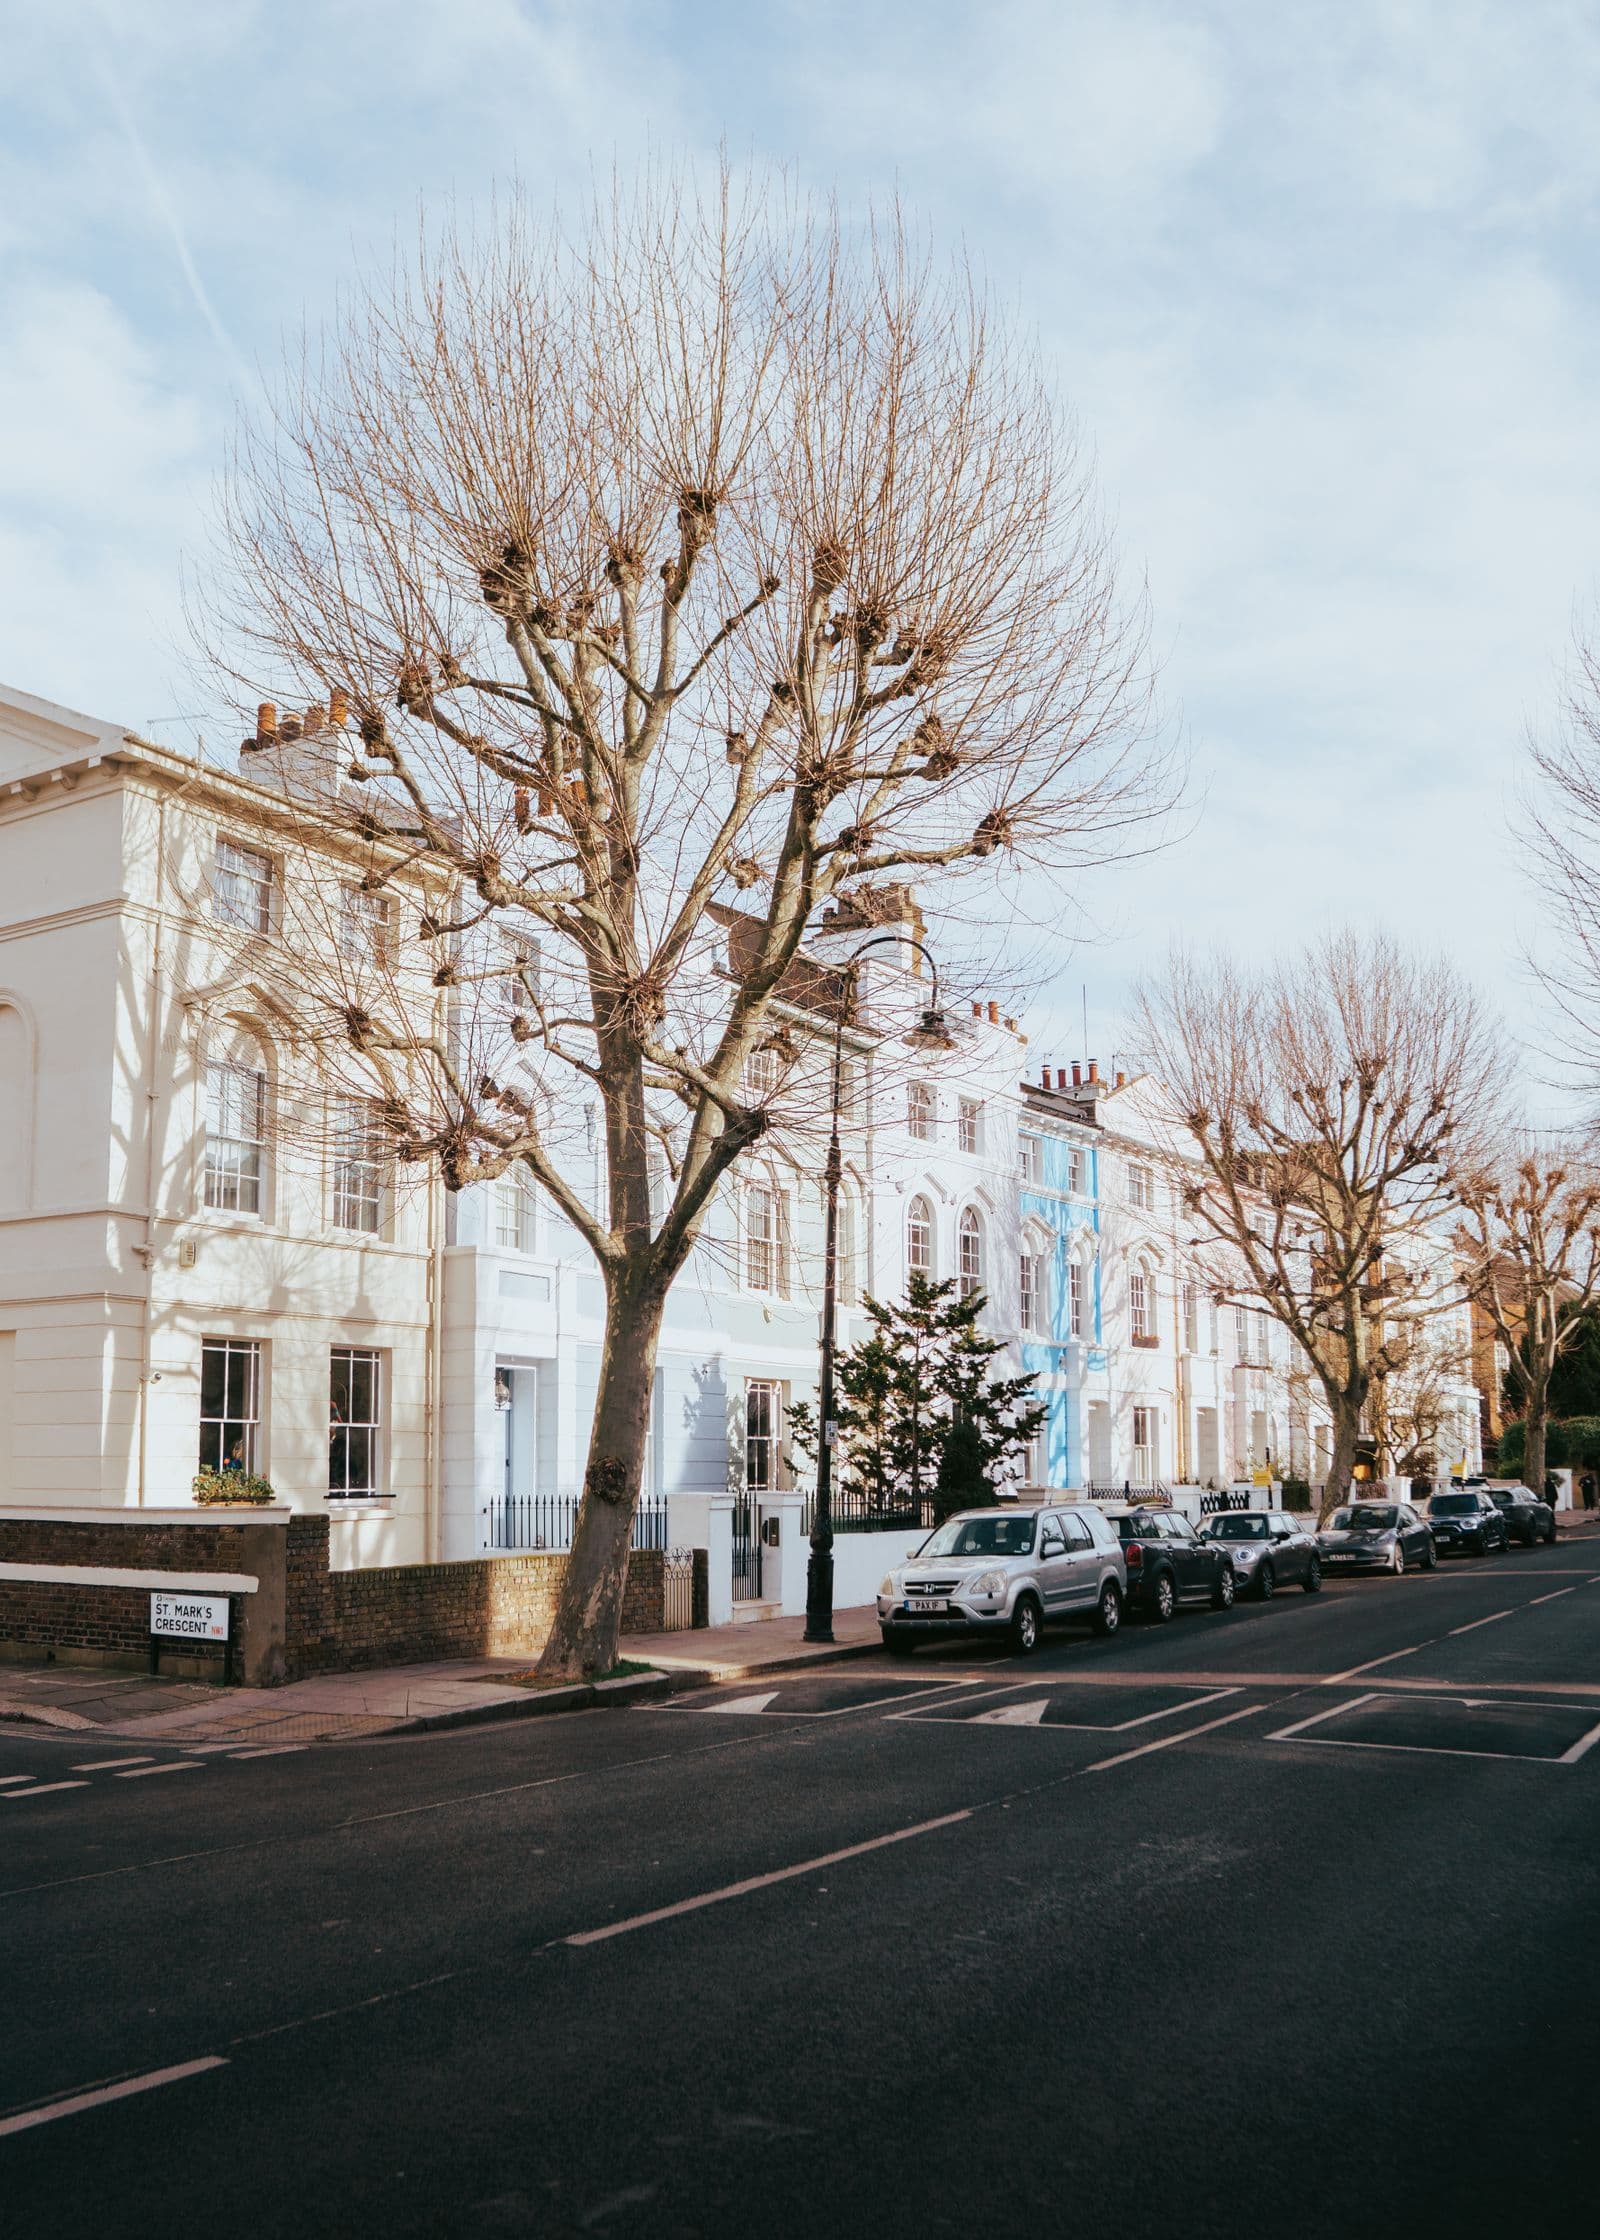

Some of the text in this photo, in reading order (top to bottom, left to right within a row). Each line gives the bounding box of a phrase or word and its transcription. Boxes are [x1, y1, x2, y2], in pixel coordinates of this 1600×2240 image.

[155, 1603, 212, 1619] ST. MARK'S
[915, 1601, 930, 1609] PAX
[155, 1618, 207, 1633] CRESCENT
